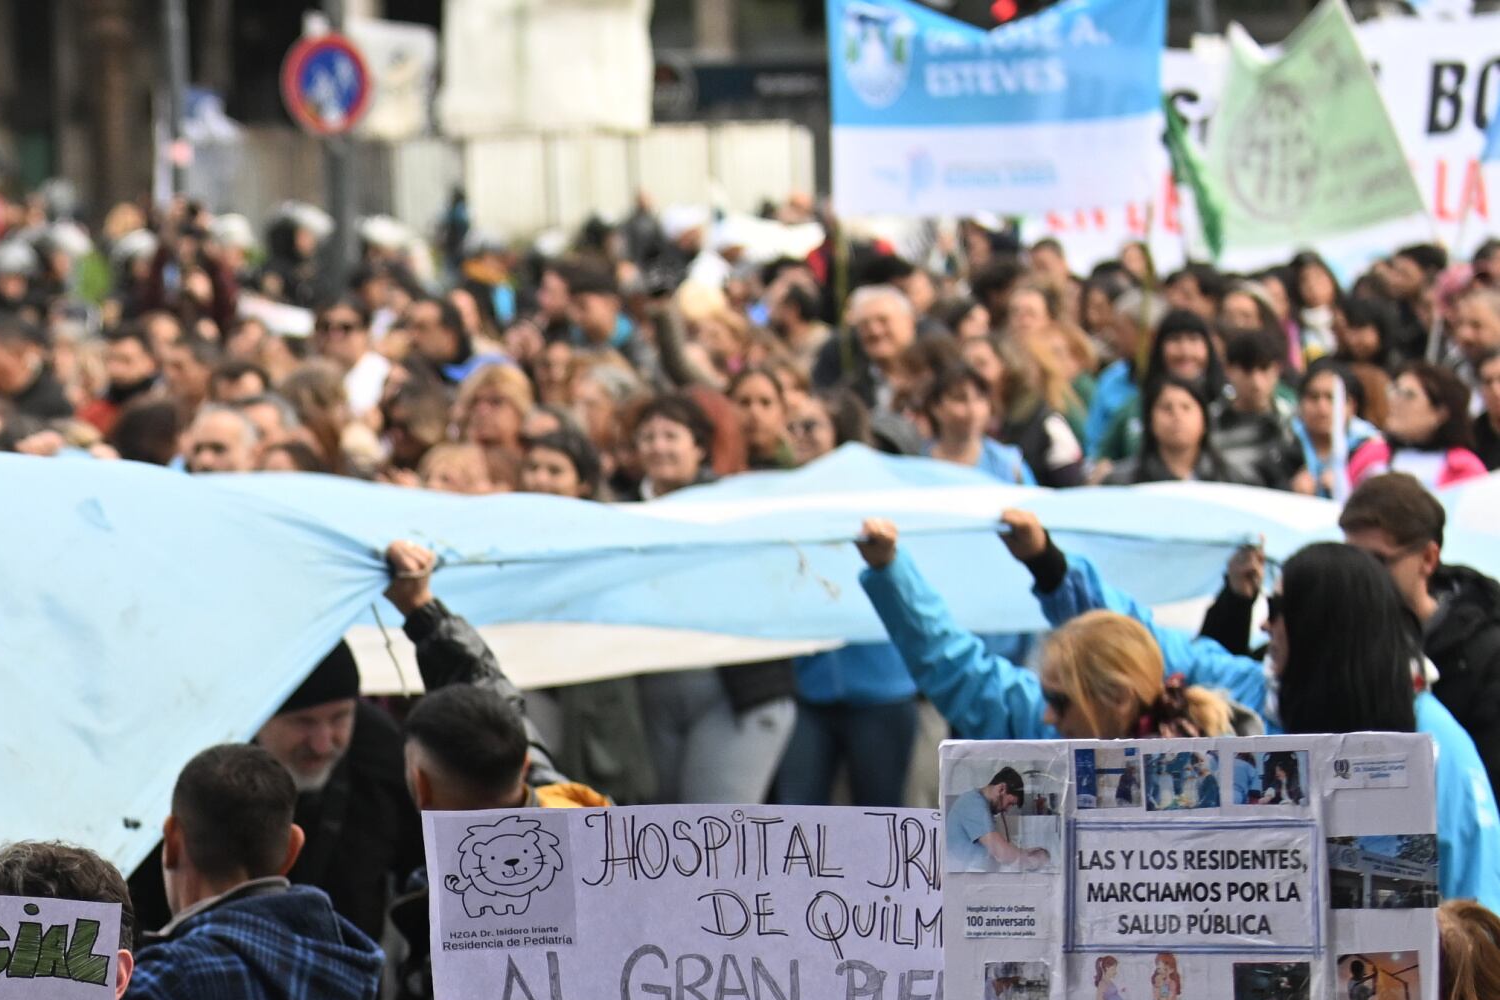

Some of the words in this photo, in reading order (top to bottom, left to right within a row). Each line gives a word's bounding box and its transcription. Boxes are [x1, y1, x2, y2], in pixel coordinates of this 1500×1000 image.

[1078, 850, 1116, 870] LAS
[1121, 850, 1134, 870] Y
[1139, 850, 1178, 870] LOS
[1184, 849, 1308, 873] RESIDENTES,
[1087, 882, 1221, 903] MARCHAMOS
[1227, 882, 1269, 903] POR
[1275, 882, 1301, 902] LA
[697, 889, 789, 940] DE
[966, 915, 983, 926] 100
[985, 915, 1035, 927] aniversario
[1117, 914, 1181, 935] SALUD
[1187, 908, 1272, 935] PÚBLICA
[443, 940, 503, 951] Residencia
[506, 938, 520, 948] de
[523, 935, 573, 946] Pediatría
[450, 930, 477, 939] HZGA
[480, 929, 494, 938] Dr.
[496, 927, 528, 936] Isidoro
